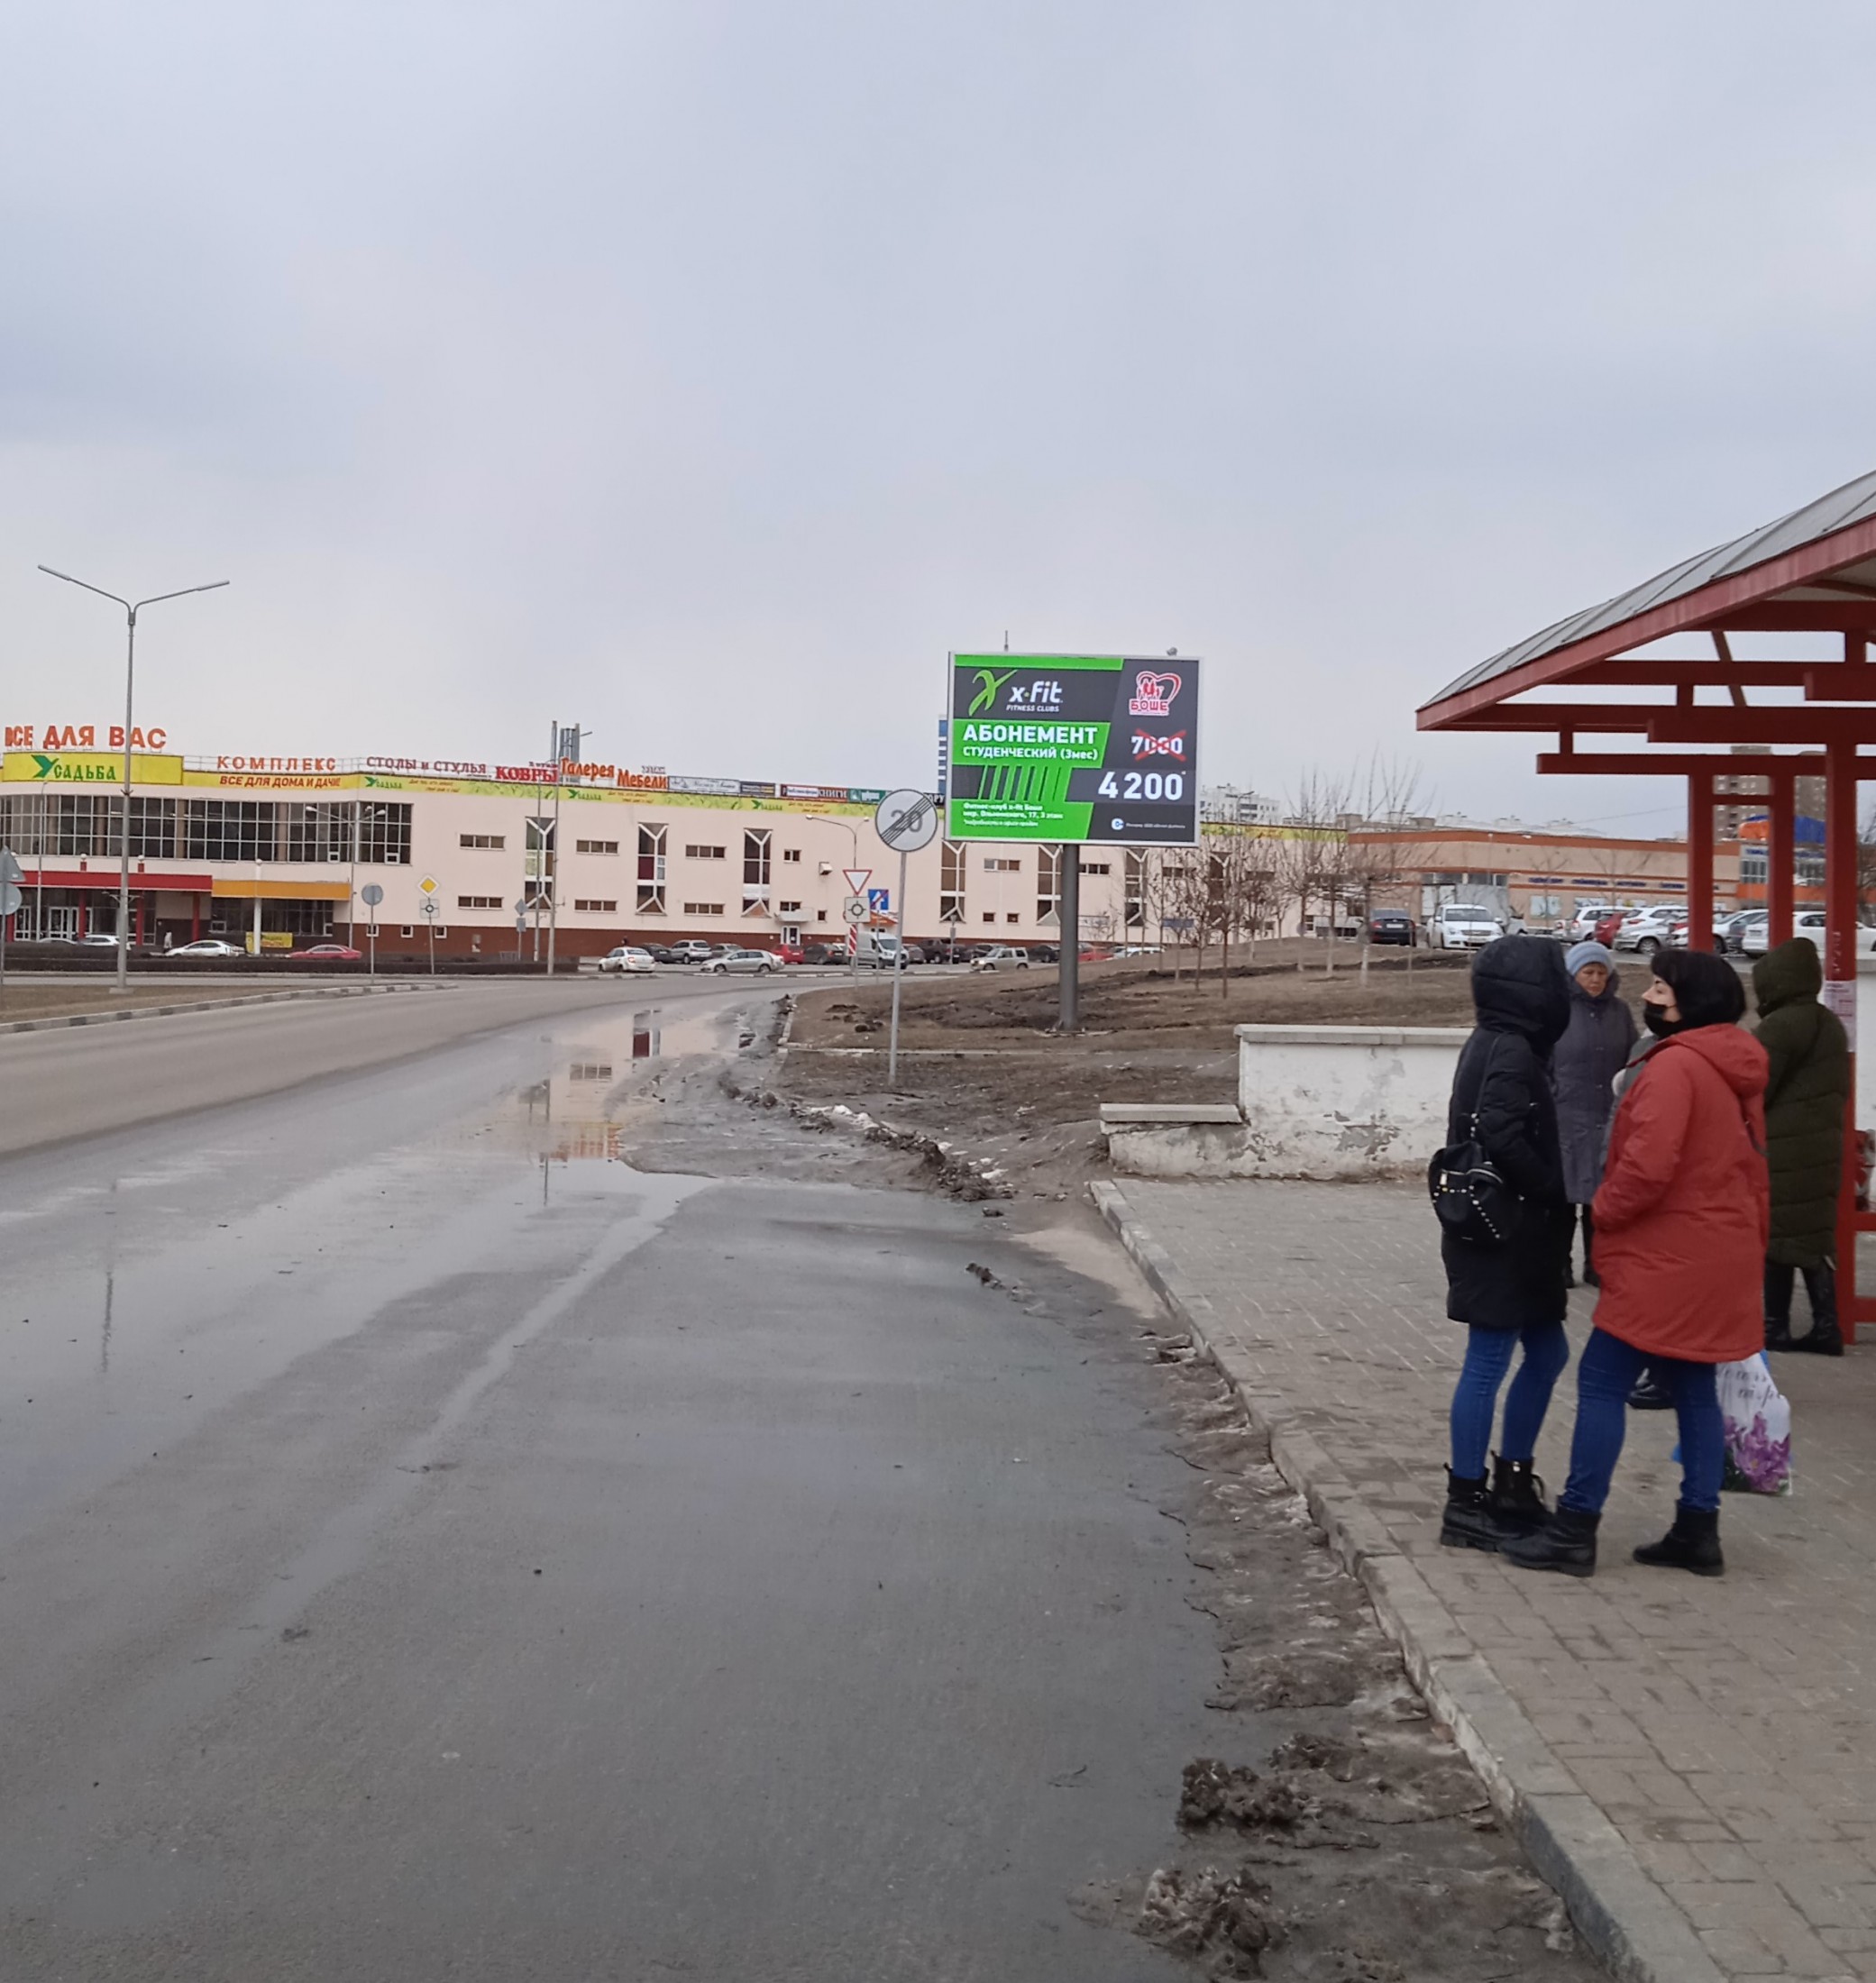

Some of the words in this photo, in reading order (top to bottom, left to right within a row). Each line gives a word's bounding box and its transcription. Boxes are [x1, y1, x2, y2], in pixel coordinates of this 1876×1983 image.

[1006, 704, 1035, 712] FITNESS
[1130, 699, 1168, 711] БОШЕ
[43, 726, 95, 749] ДЛЯ
[109, 726, 166, 749] ВАС
[963, 724, 1098, 745] АБОНЕМЕНТ
[963, 745, 1057, 759] СТУДЕНЧЕСКИЙ
[1060, 748, 1098, 761] (3мес)
[216, 755, 336, 772] КОМПЛЕКС
[366, 756, 416, 771] СТОЛЫ
[433, 760, 487, 775] СТУЛЬЯ
[220, 775, 243, 785] ВСЕ
[244, 776, 270, 788] ДЛЯ
[271, 777, 304, 788] ДОМА
[495, 765, 558, 783] КОВРЫ
[561, 757, 615, 781] Галерея
[617, 768, 668, 790] Мебели
[891, 809, 923, 833] 20
